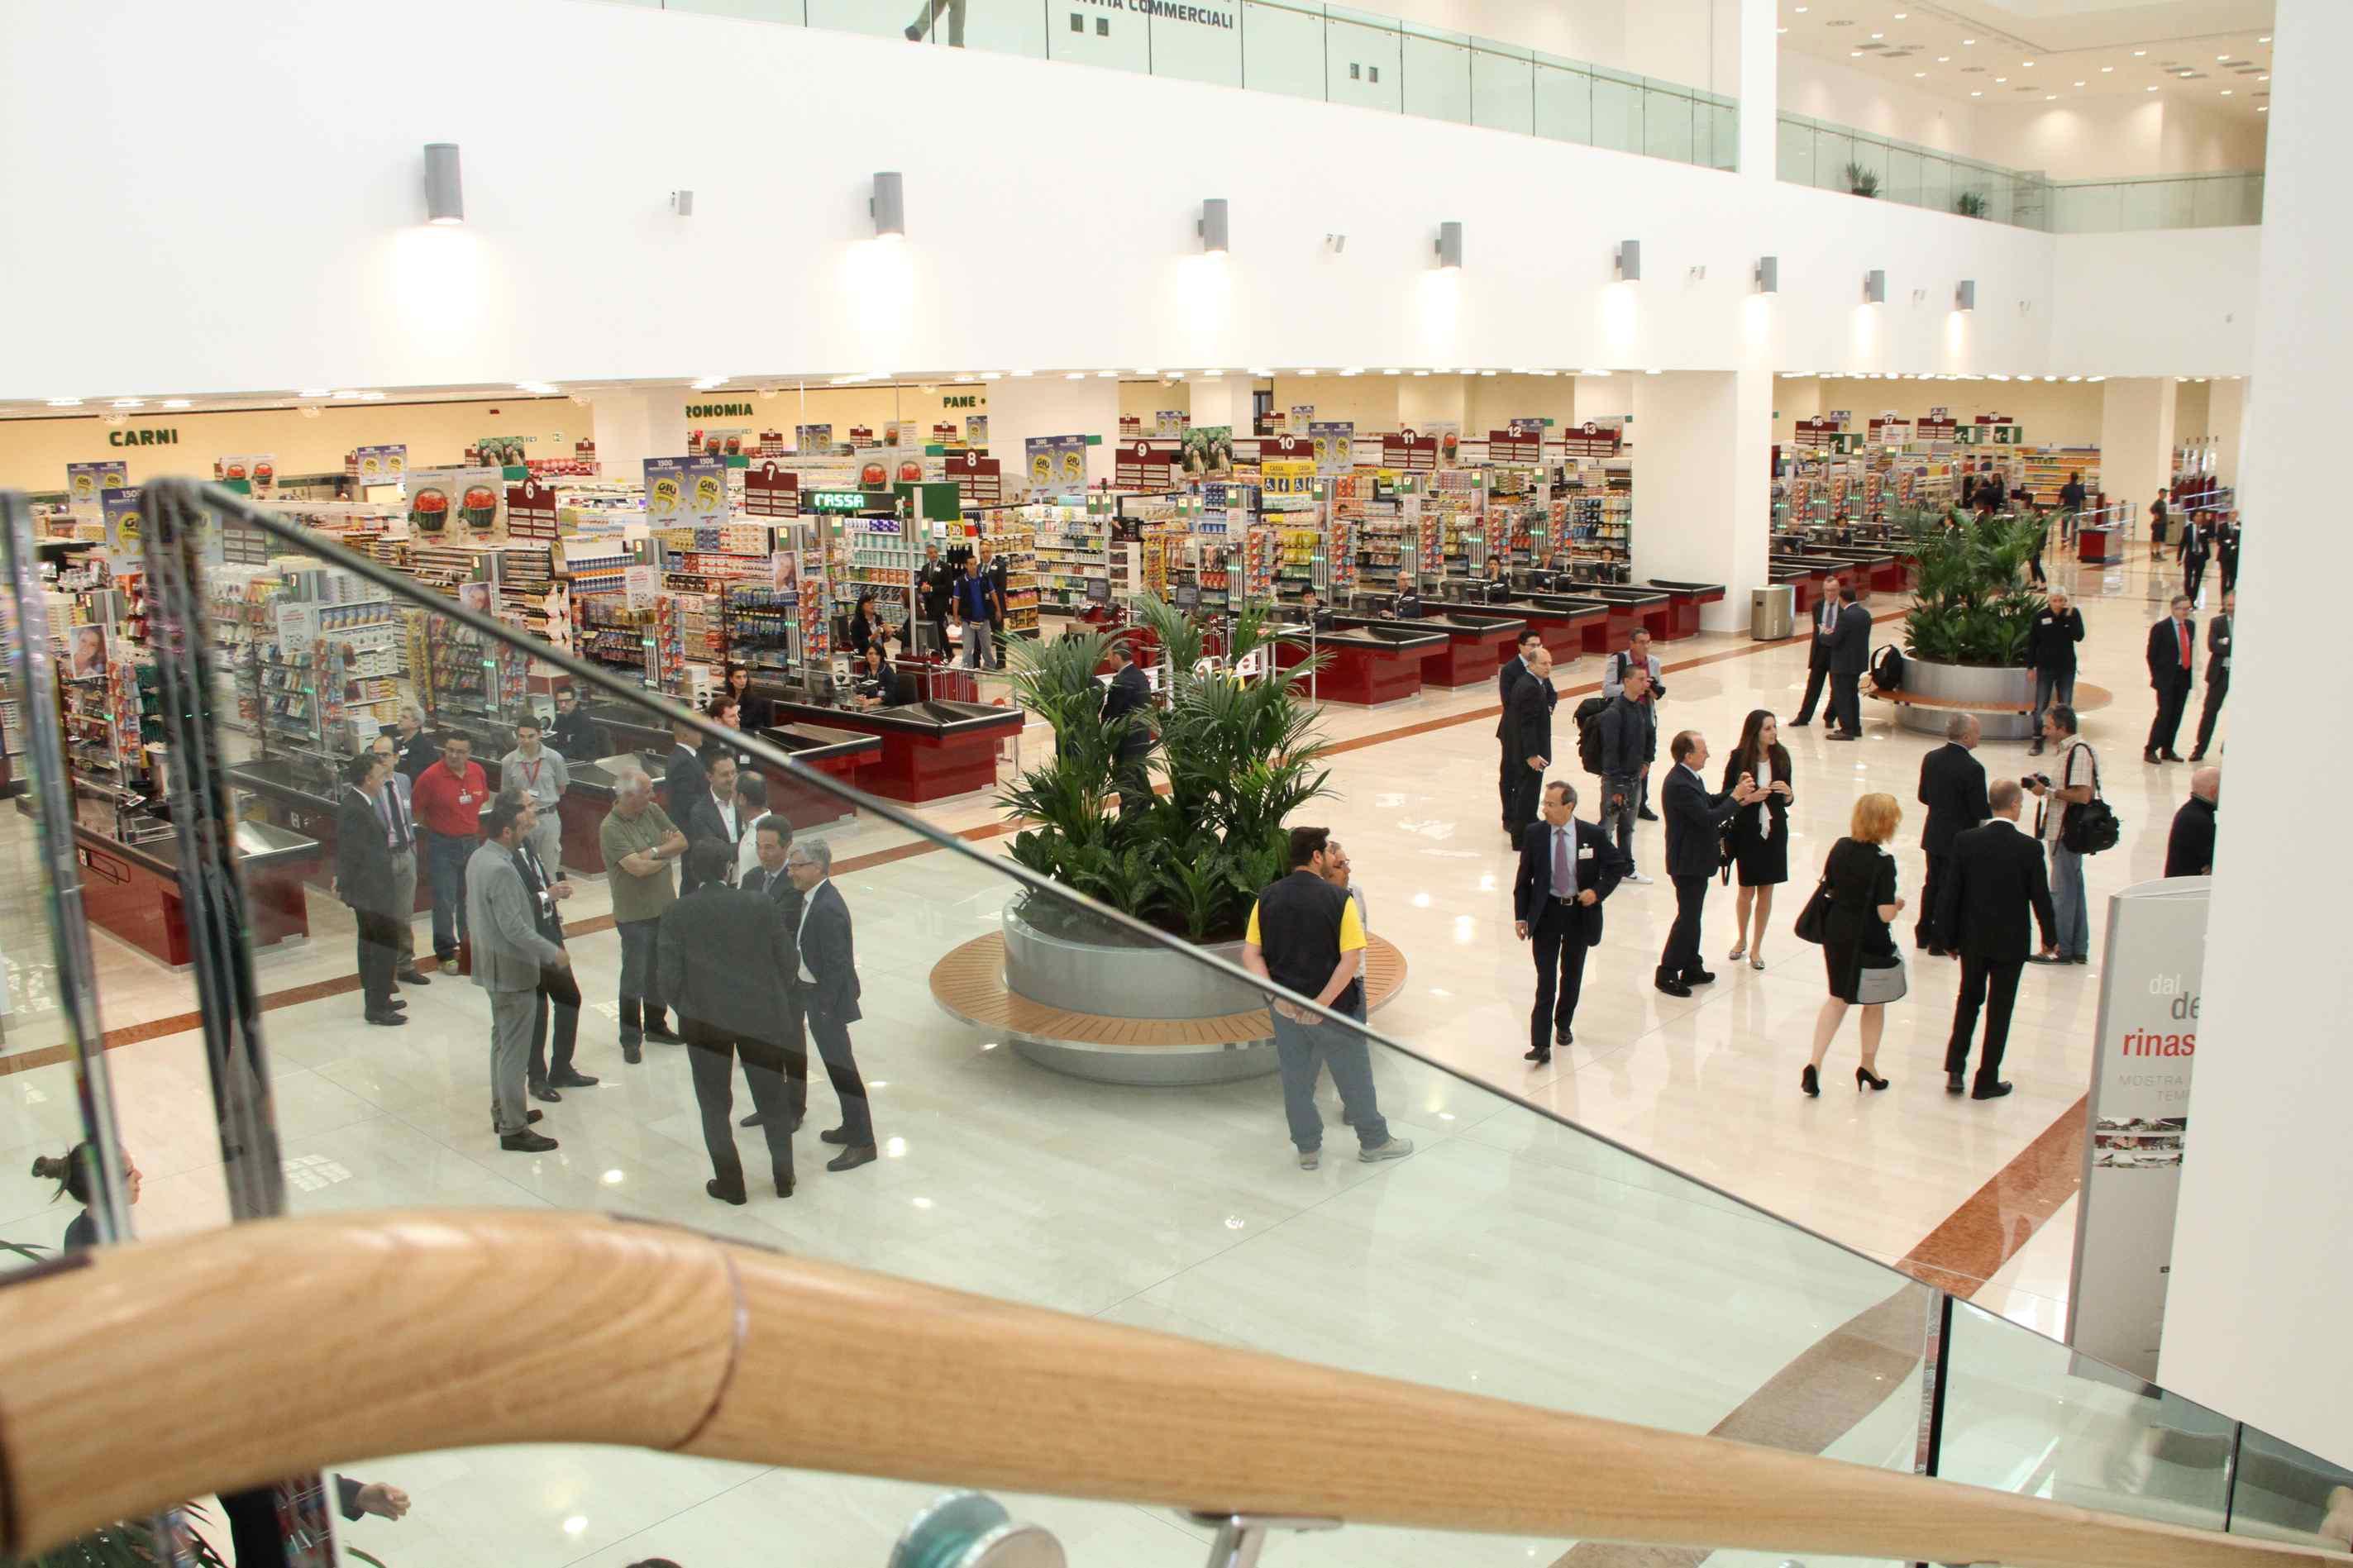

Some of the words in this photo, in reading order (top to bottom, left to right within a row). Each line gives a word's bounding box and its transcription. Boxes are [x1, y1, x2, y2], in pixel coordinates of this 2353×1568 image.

[1129, 0, 1233, 30] COMMERCIALI
[943, 397, 976, 408] PANE
[1507, 425, 1522, 438] 12
[1583, 422, 1597, 436] 13
[109, 429, 179, 447] CARNI
[1278, 437, 1295, 450] 10
[1402, 433, 1415, 446] 11
[1138, 442, 1148, 457] 9
[966, 451, 977, 467] 8
[766, 465, 776, 481] 7
[525, 482, 534, 499] 6
[291, 574, 298, 588] 7
[2149, 973, 2183, 995] dal
[2119, 1075, 2184, 1087] MOSTRA
